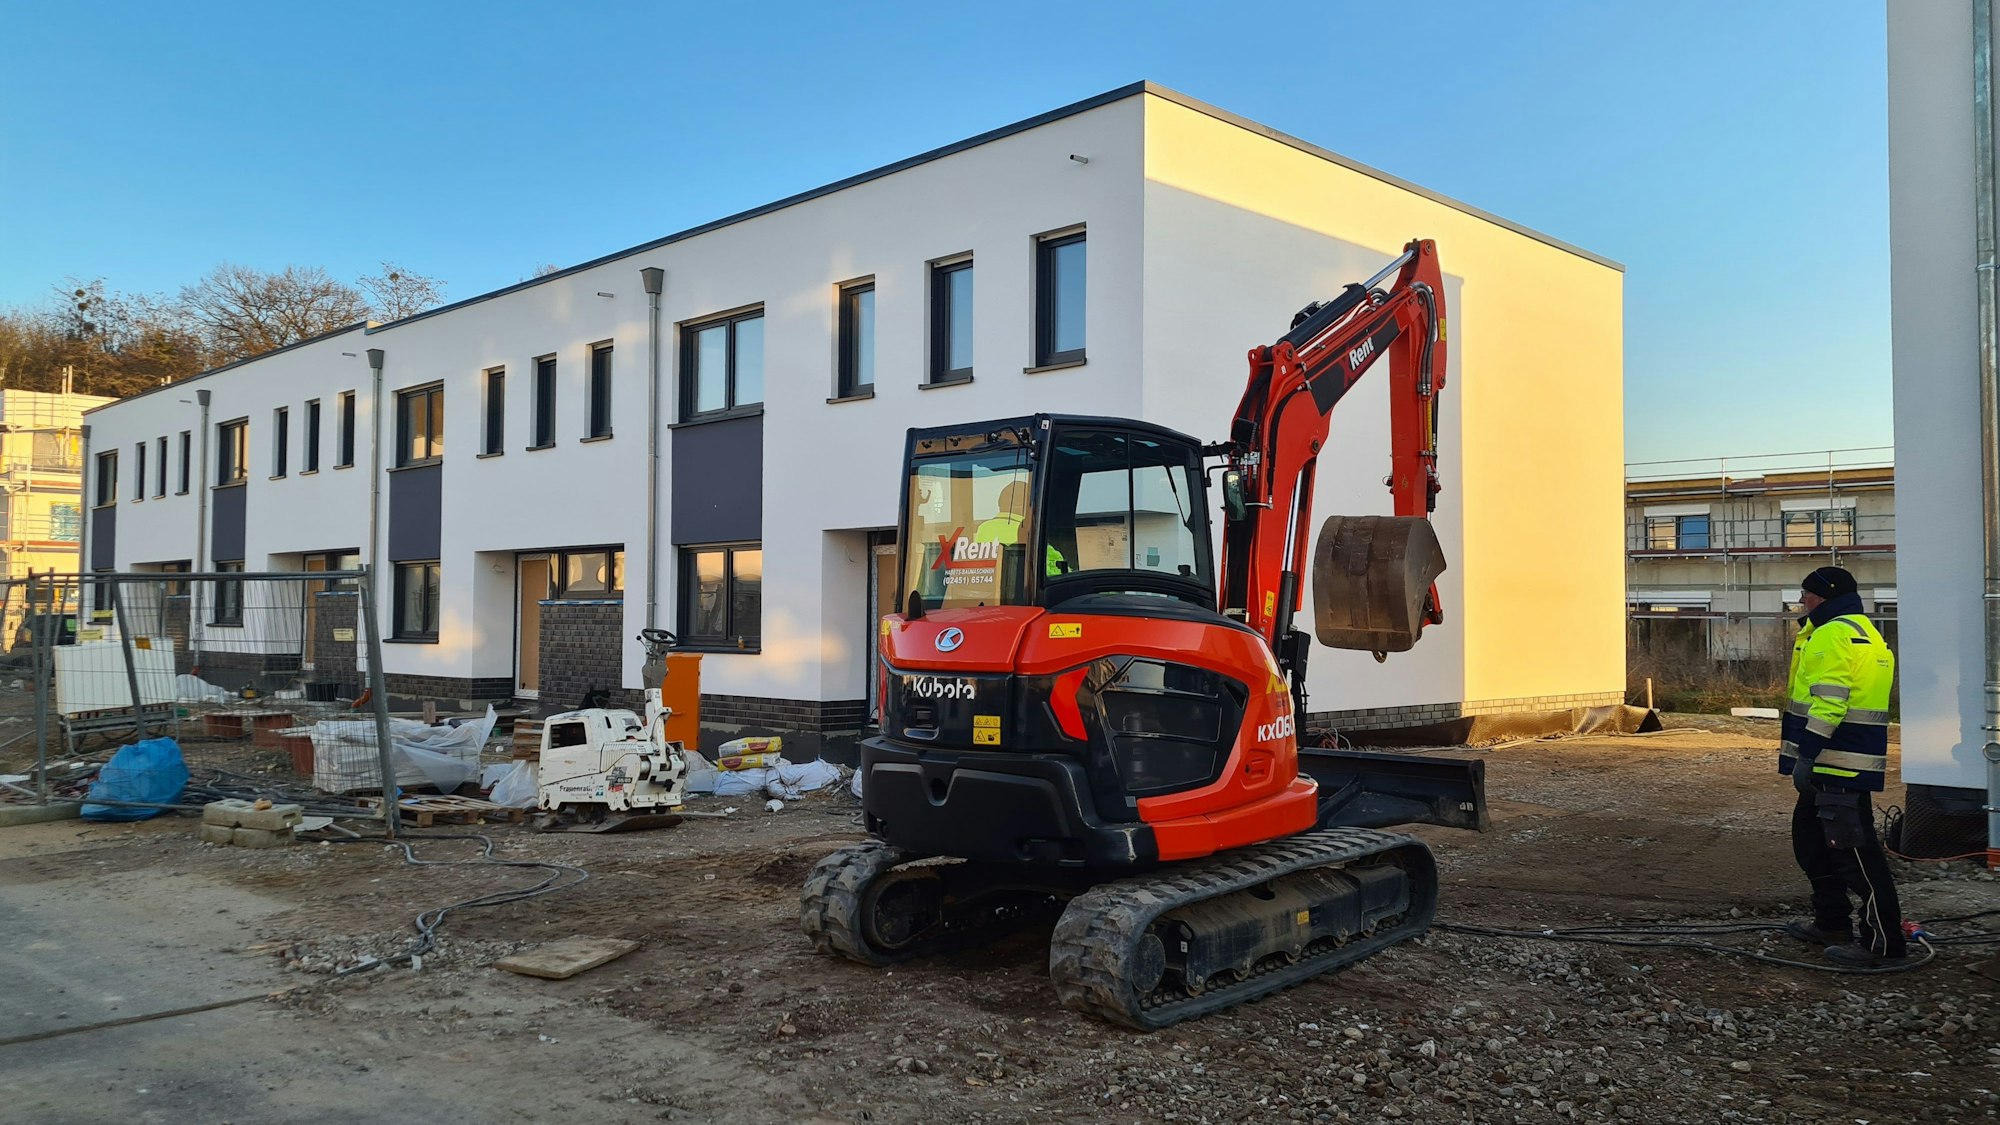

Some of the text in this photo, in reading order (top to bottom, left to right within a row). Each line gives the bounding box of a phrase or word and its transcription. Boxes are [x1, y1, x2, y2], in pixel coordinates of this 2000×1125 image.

[931, 527, 1000, 570] XRent
[943, 576, 993, 586] (02451) 65744
[913, 677, 975, 699] Kubota
